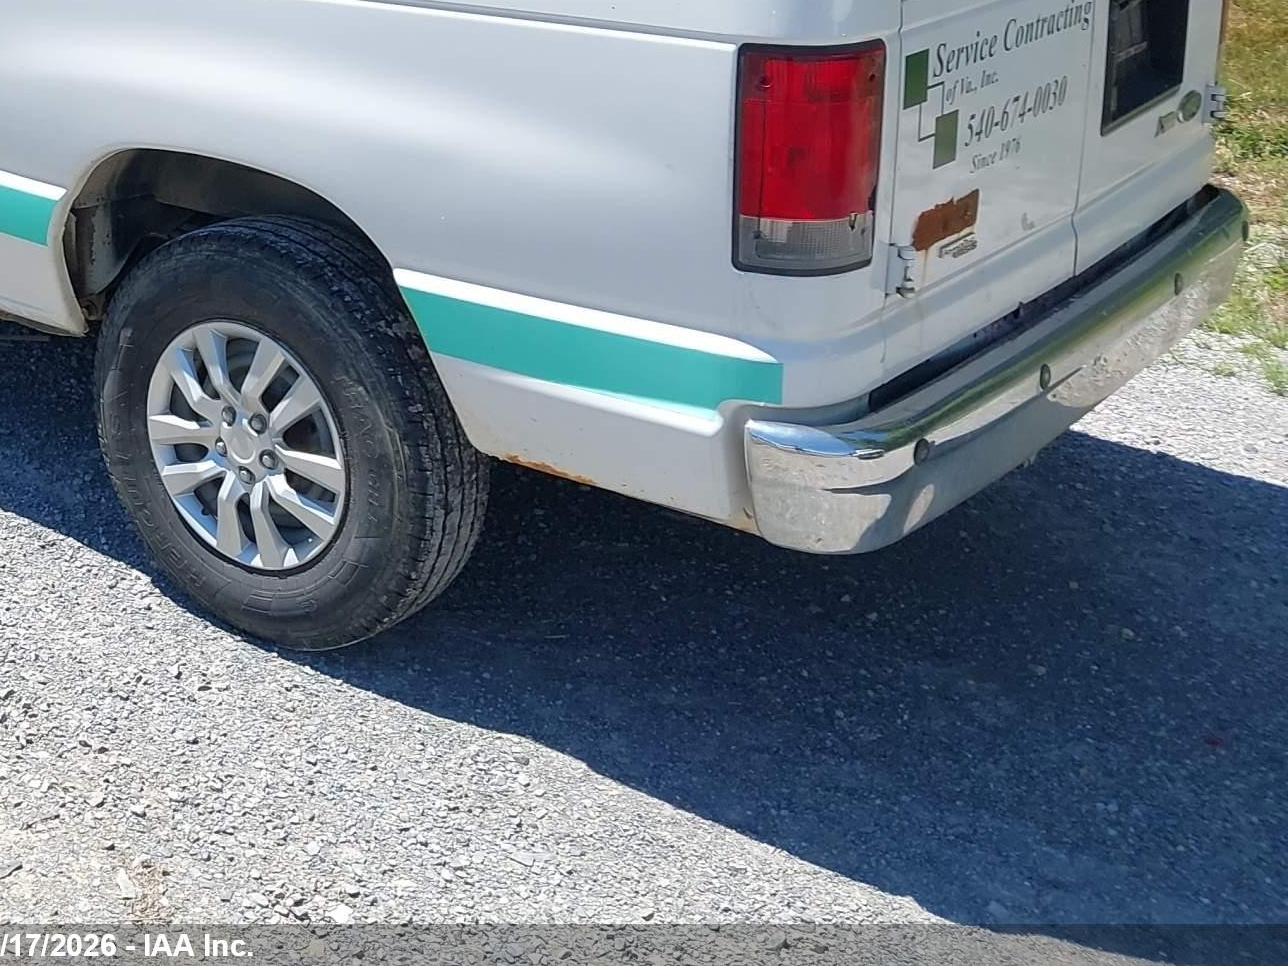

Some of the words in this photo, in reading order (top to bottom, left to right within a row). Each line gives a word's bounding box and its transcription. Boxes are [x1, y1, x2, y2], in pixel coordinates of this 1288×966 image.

[933, 31, 998, 78] Service
[964, 75, 1068, 147] 540-674-0030
[969, 151, 997, 174] Since
